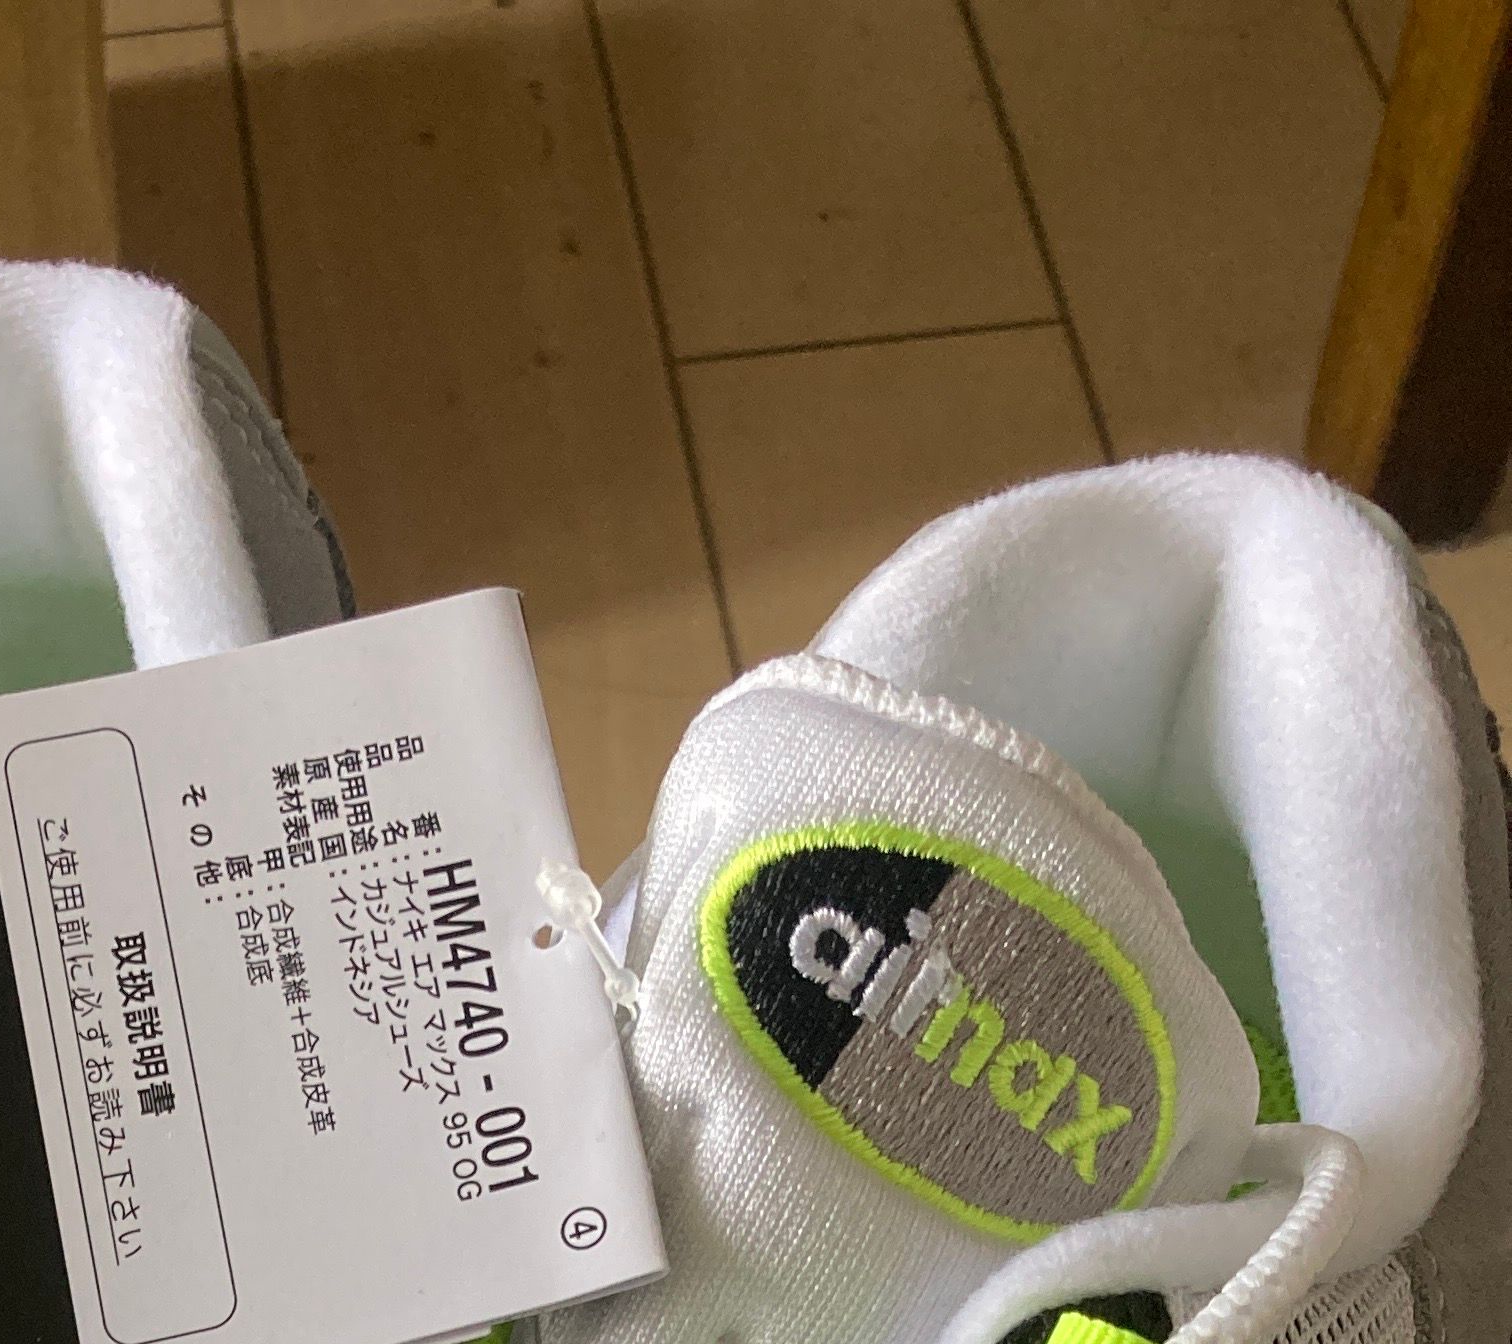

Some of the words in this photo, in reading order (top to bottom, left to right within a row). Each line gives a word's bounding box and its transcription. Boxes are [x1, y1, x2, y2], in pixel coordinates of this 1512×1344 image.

[270, 761, 318, 870] 素材表記
[234, 904, 276, 988] 合成底
[329, 884, 382, 1026] インドネシア
[391, 869, 429, 944] ナイキ
[109, 930, 177, 1118] 取扱説明書
[258, 897, 337, 1137] 合成繊維＋合成皮革
[359, 876, 431, 1094] カジュアルシューズ
[409, 951, 442, 1000] エア
[35, 816, 143, 1260] ご使用前に必ずお読み下さい
[422, 1007, 462, 1106] マックス
[441, 1110, 474, 1151] 95
[451, 1157, 484, 1203] OG
